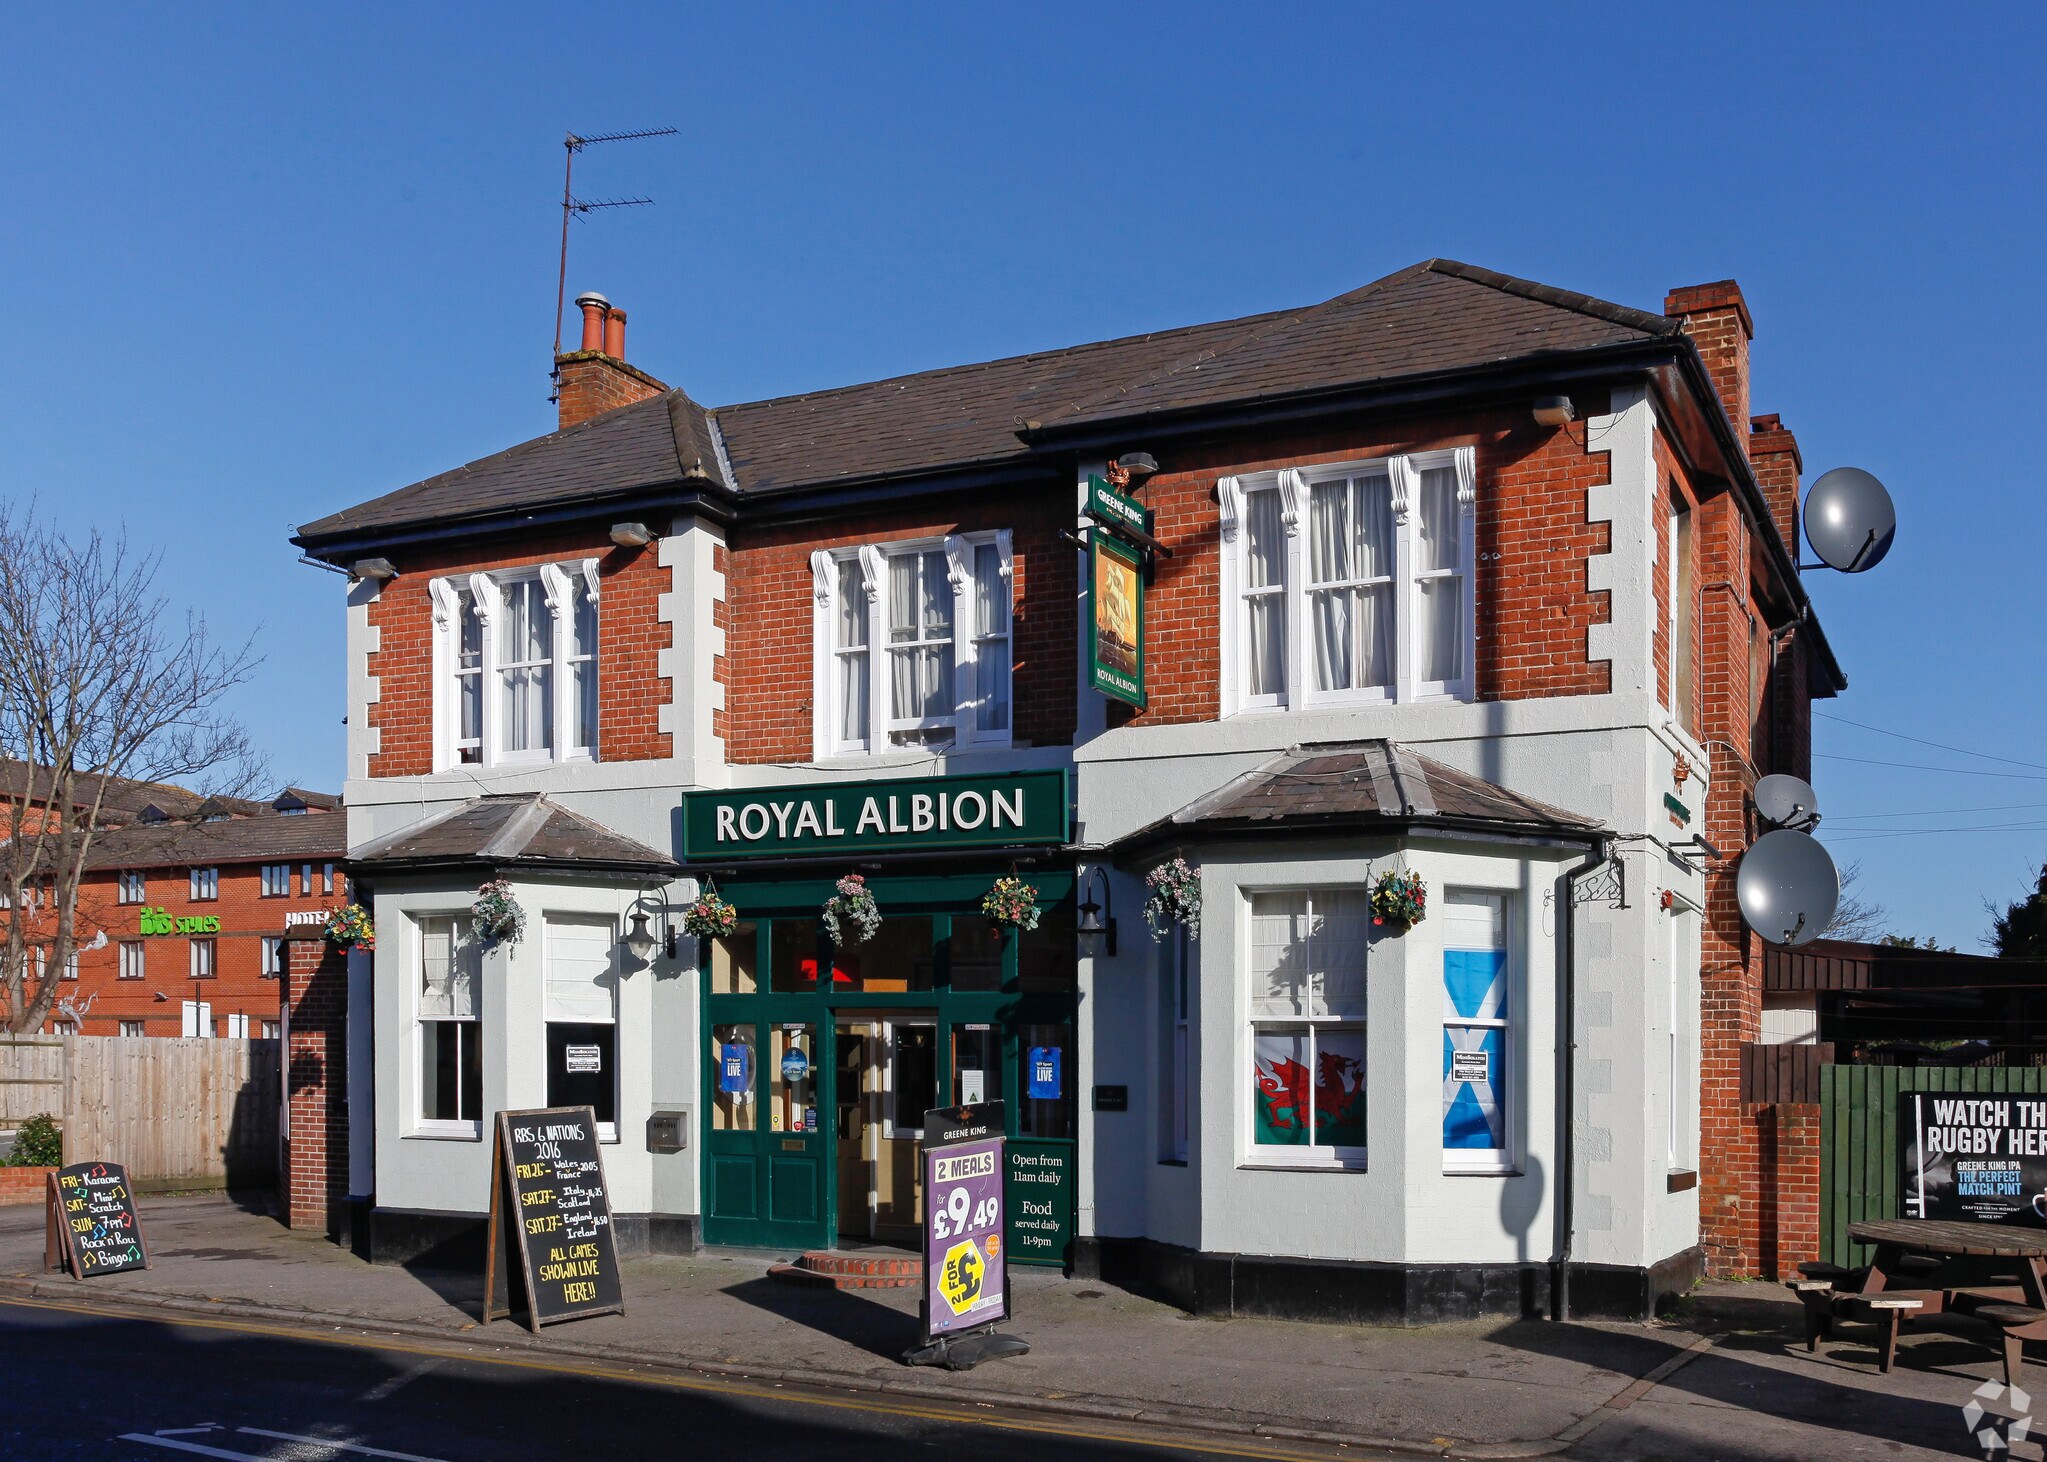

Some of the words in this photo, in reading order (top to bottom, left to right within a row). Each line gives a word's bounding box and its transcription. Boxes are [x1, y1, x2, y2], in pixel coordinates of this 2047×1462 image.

[1098, 489, 1124, 513] GREENE
[1125, 505, 1142, 525] KING
[1097, 668, 1115, 684] ROYAL
[1115, 677, 1137, 694] ALBION
[717, 798, 845, 841] ROYAL
[856, 788, 1024, 834] ALBION
[140, 907, 172, 935] ibis
[727, 1065, 741, 1077] LIVE
[1037, 1069, 1052, 1082] LIVE
[1933, 1099, 2009, 1127] WATCH
[2016, 1101, 2046, 1128] TH
[514, 1127, 535, 1143] RBS
[538, 1127, 546, 1142] 6
[546, 1124, 585, 1141] NATIONS
[943, 1128, 969, 1140] GREENE
[970, 1126, 987, 1136] KING
[1927, 1126, 2001, 1153] RUGBY
[534, 1141, 561, 1160] 2016
[938, 1161, 946, 1179] 2
[951, 1154, 992, 1177] MEALS
[1012, 1153, 1038, 1167] Open
[1039, 1154, 1063, 1167] from
[1957, 1161, 1986, 1171] GREENE
[1988, 1161, 2007, 1171] KING
[2008, 1161, 2021, 1170] IPA
[516, 1164, 532, 1178] FRI
[554, 1160, 578, 1169] Wales
[556, 1171, 581, 1180] France
[82, 1172, 121, 1186] Karaoke
[1013, 1171, 1036, 1182] 11am
[1038, 1171, 1061, 1186] daily
[1958, 1171, 1977, 1182] THE
[1979, 1171, 2021, 1183] PERFECT
[93, 1191, 113, 1203] Mini
[521, 1191, 538, 1206] SAT
[563, 1185, 586, 1197] Italy
[1958, 1183, 1994, 1195] MATCH
[1997, 1183, 2022, 1196] PINT
[557, 1196, 591, 1209] Scotland
[936, 1194, 945, 1205] for
[89, 1202, 124, 1213] Scratch
[934, 1187, 999, 1240] £9.49
[1022, 1201, 1052, 1215] Food
[526, 1217, 545, 1234] SAT
[563, 1211, 592, 1226] England
[1015, 1219, 1040, 1229] served
[1041, 1219, 1060, 1232] daily
[566, 1225, 598, 1239] Ireland
[1022, 1235, 1052, 1248] 11-9pm
[98, 1250, 128, 1268] Bingo
[550, 1247, 567, 1262] ALL
[569, 1243, 599, 1259] GAMES
[540, 1261, 577, 1281] SHOWN
[578, 1259, 600, 1276] LIVE
[947, 1259, 959, 1290] FOR
[563, 1281, 596, 1304] HERE!!
[951, 1294, 961, 1305] 2
